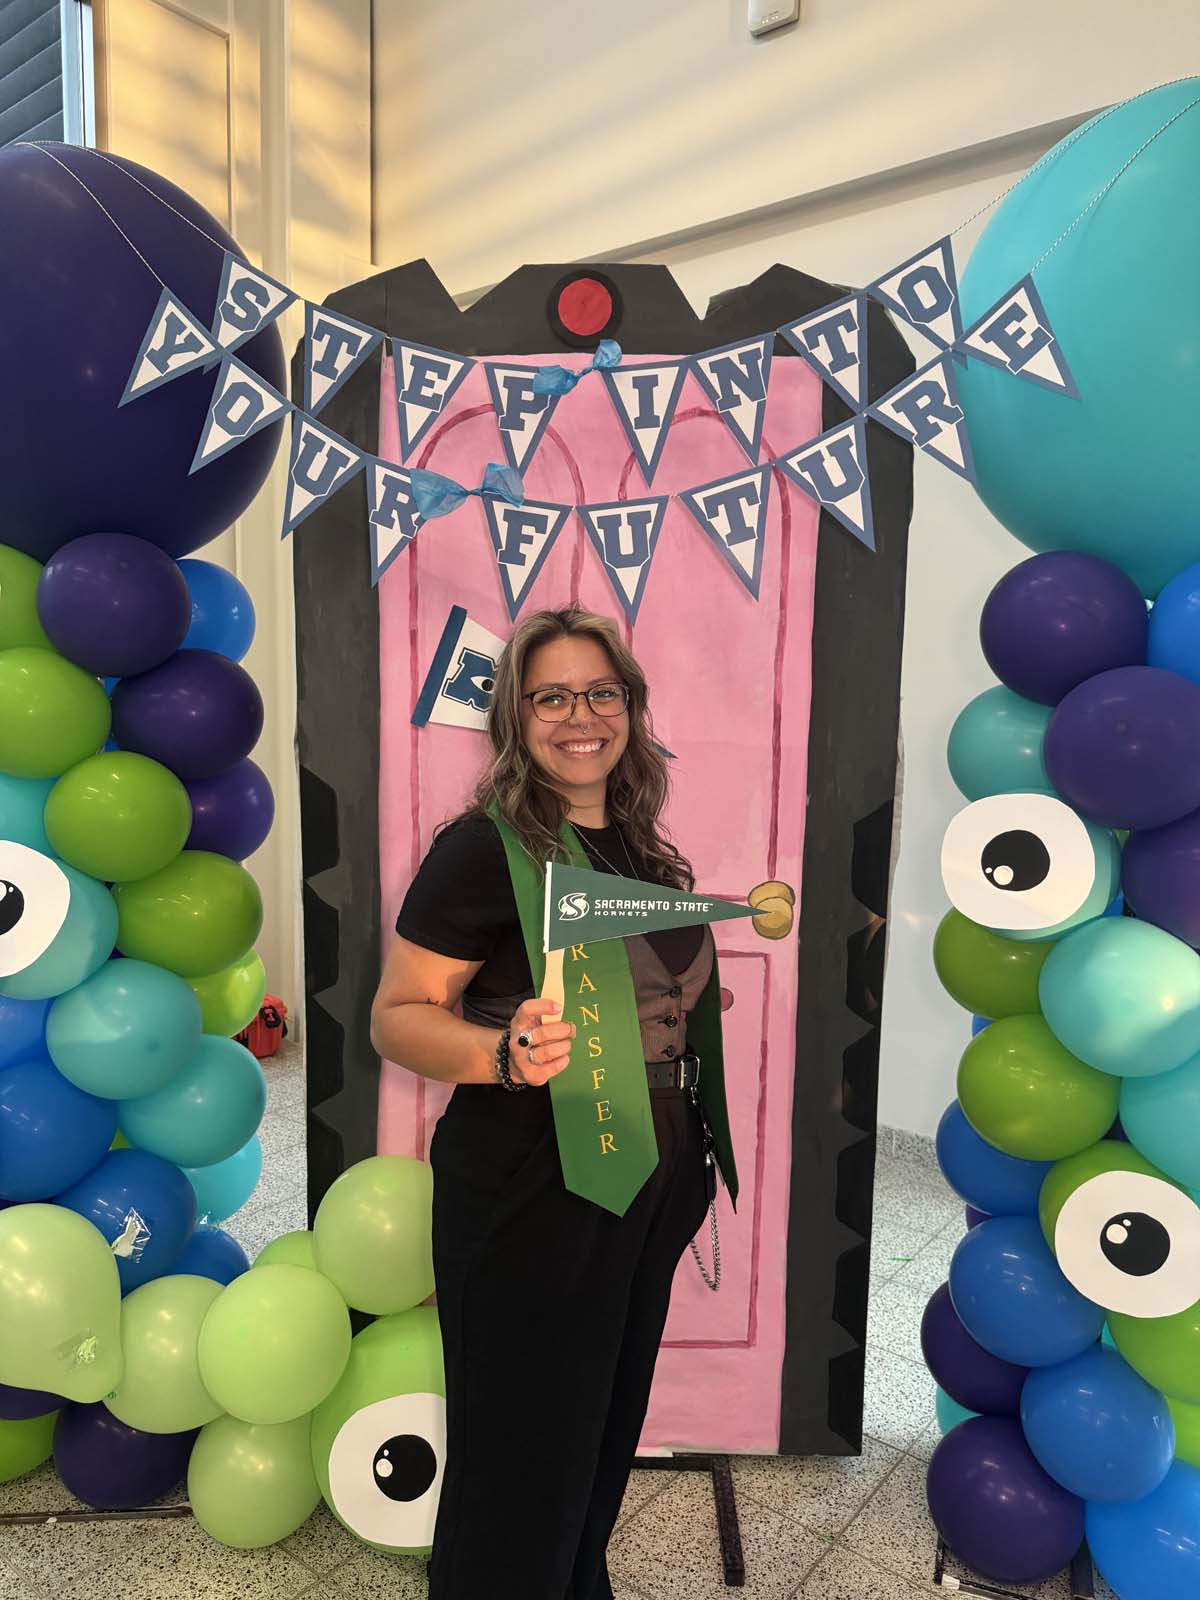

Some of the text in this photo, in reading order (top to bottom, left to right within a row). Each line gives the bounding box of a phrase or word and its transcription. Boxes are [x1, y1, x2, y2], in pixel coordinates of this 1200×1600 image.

[144, 302, 1054, 569] YOUR FUTURE
[219, 264, 955, 431] STEP INTO
[594, 899, 670, 911] SACRAMENTO
[571, 943, 620, 1155] RANSFER
